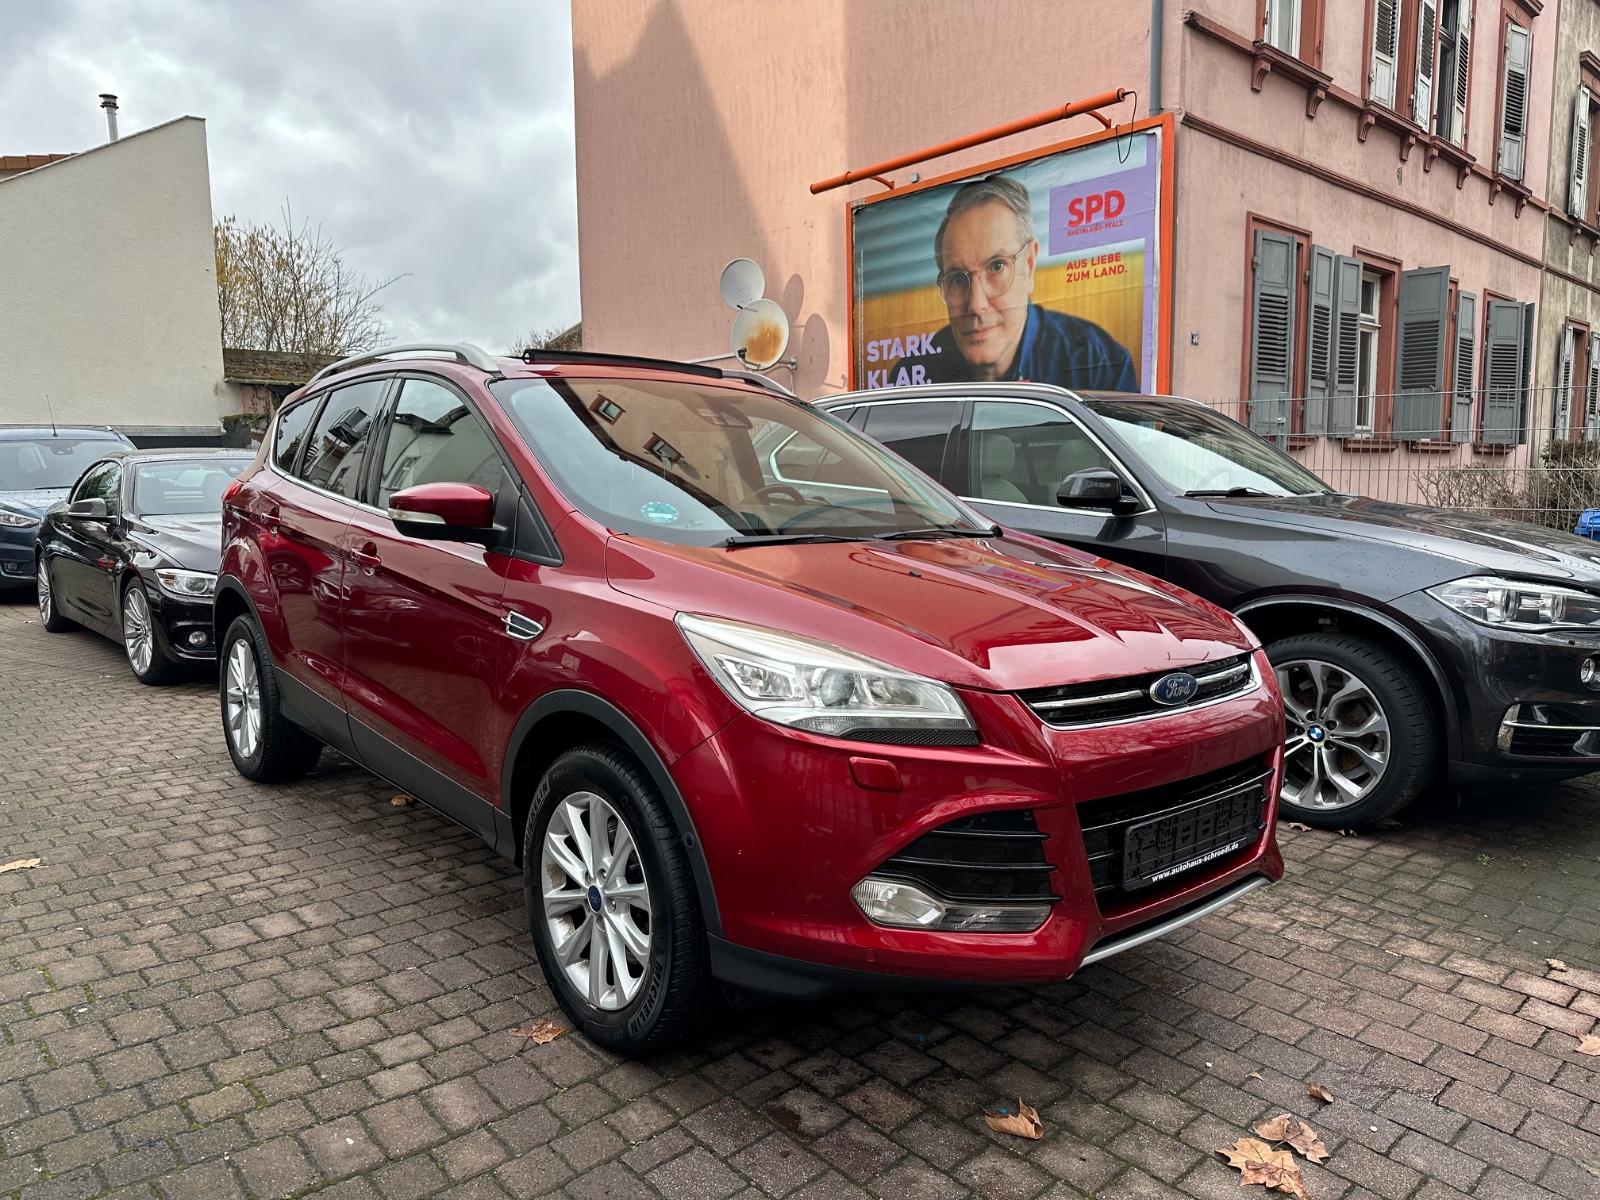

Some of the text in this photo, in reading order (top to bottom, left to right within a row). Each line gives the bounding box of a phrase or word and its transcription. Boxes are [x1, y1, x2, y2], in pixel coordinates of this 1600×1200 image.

[1067, 190, 1125, 228] SPD
[1066, 252, 1121, 271] AUS LIEBE
[1066, 264, 1128, 283] ZUM LAND.
[866, 331, 942, 362] STARK.
[867, 364, 932, 390] KLAR.
[1166, 678, 1190, 699] Ford
[629, 959, 664, 1037] MICHELIN
